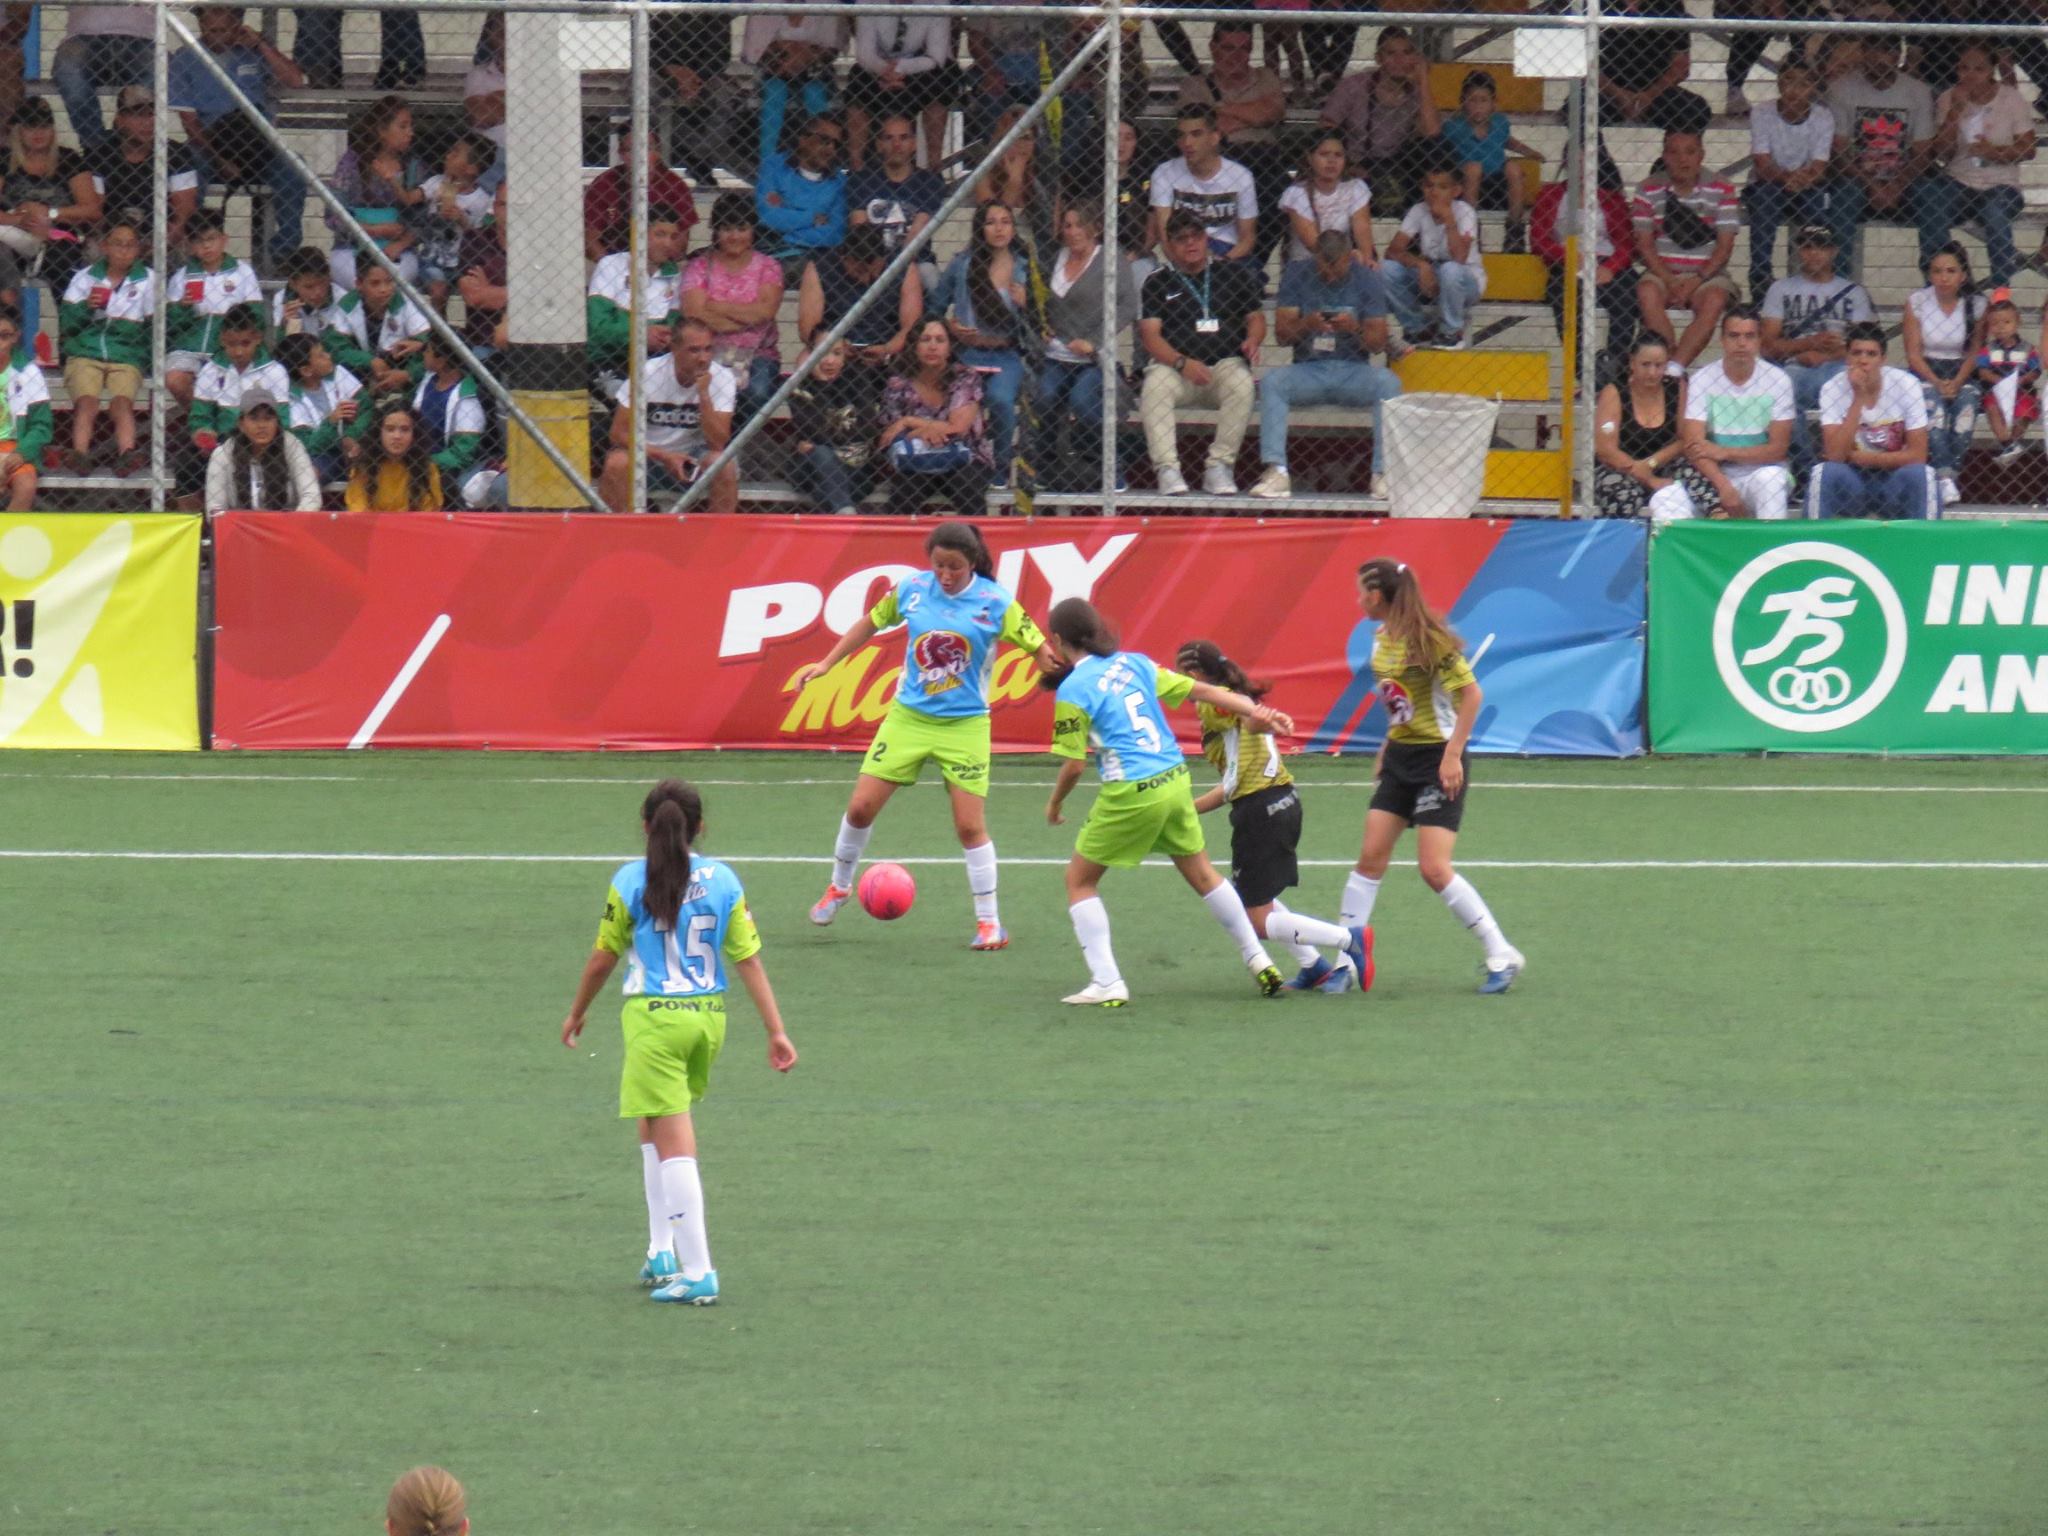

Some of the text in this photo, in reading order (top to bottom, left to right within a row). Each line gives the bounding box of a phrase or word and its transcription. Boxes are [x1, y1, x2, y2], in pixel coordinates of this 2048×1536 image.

[719, 533, 1137, 658] POY
[906, 592, 922, 612] 2
[780, 645, 1042, 732] Maa
[1123, 690, 1161, 753] 5
[872, 741, 888, 762] 2
[654, 914, 718, 993] 15
